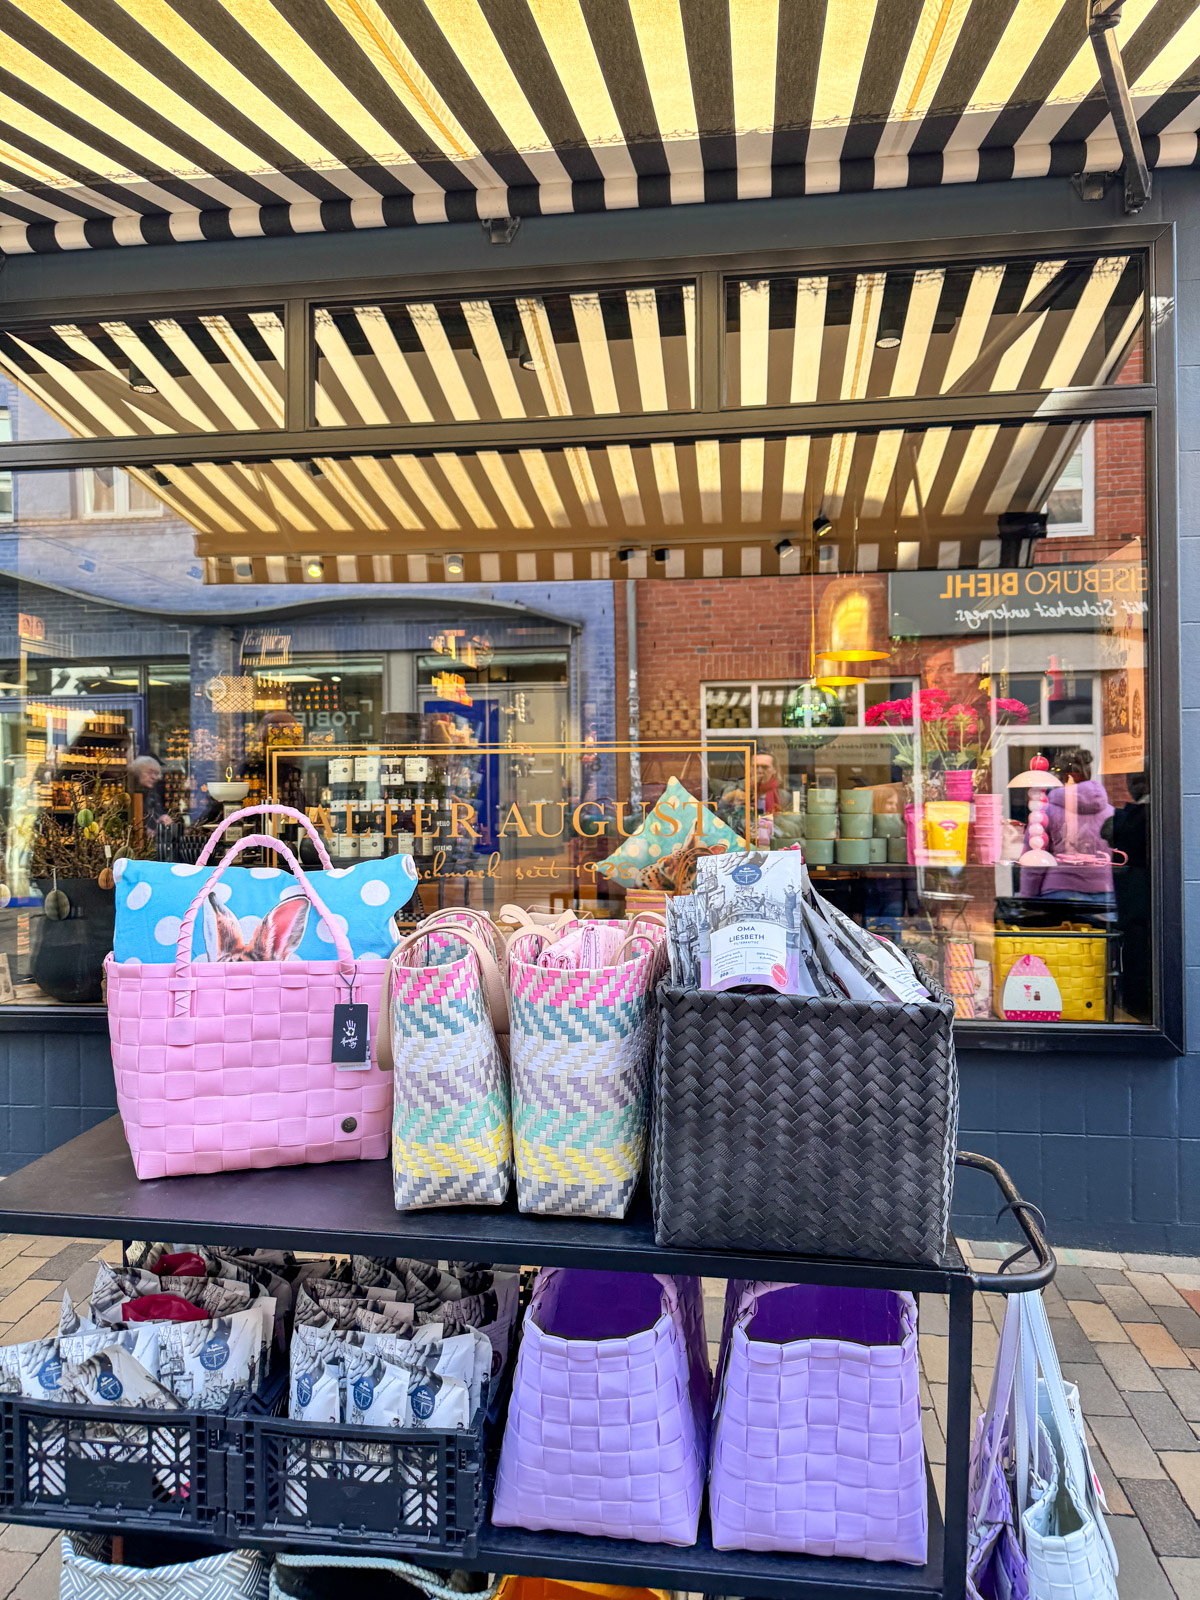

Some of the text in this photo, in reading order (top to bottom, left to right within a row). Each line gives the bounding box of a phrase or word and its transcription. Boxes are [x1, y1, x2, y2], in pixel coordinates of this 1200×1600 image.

[304, 801, 718, 839] ALTER AUGUST
[516, 857, 560, 881] seit
[729, 934, 765, 943] LIESBETH
